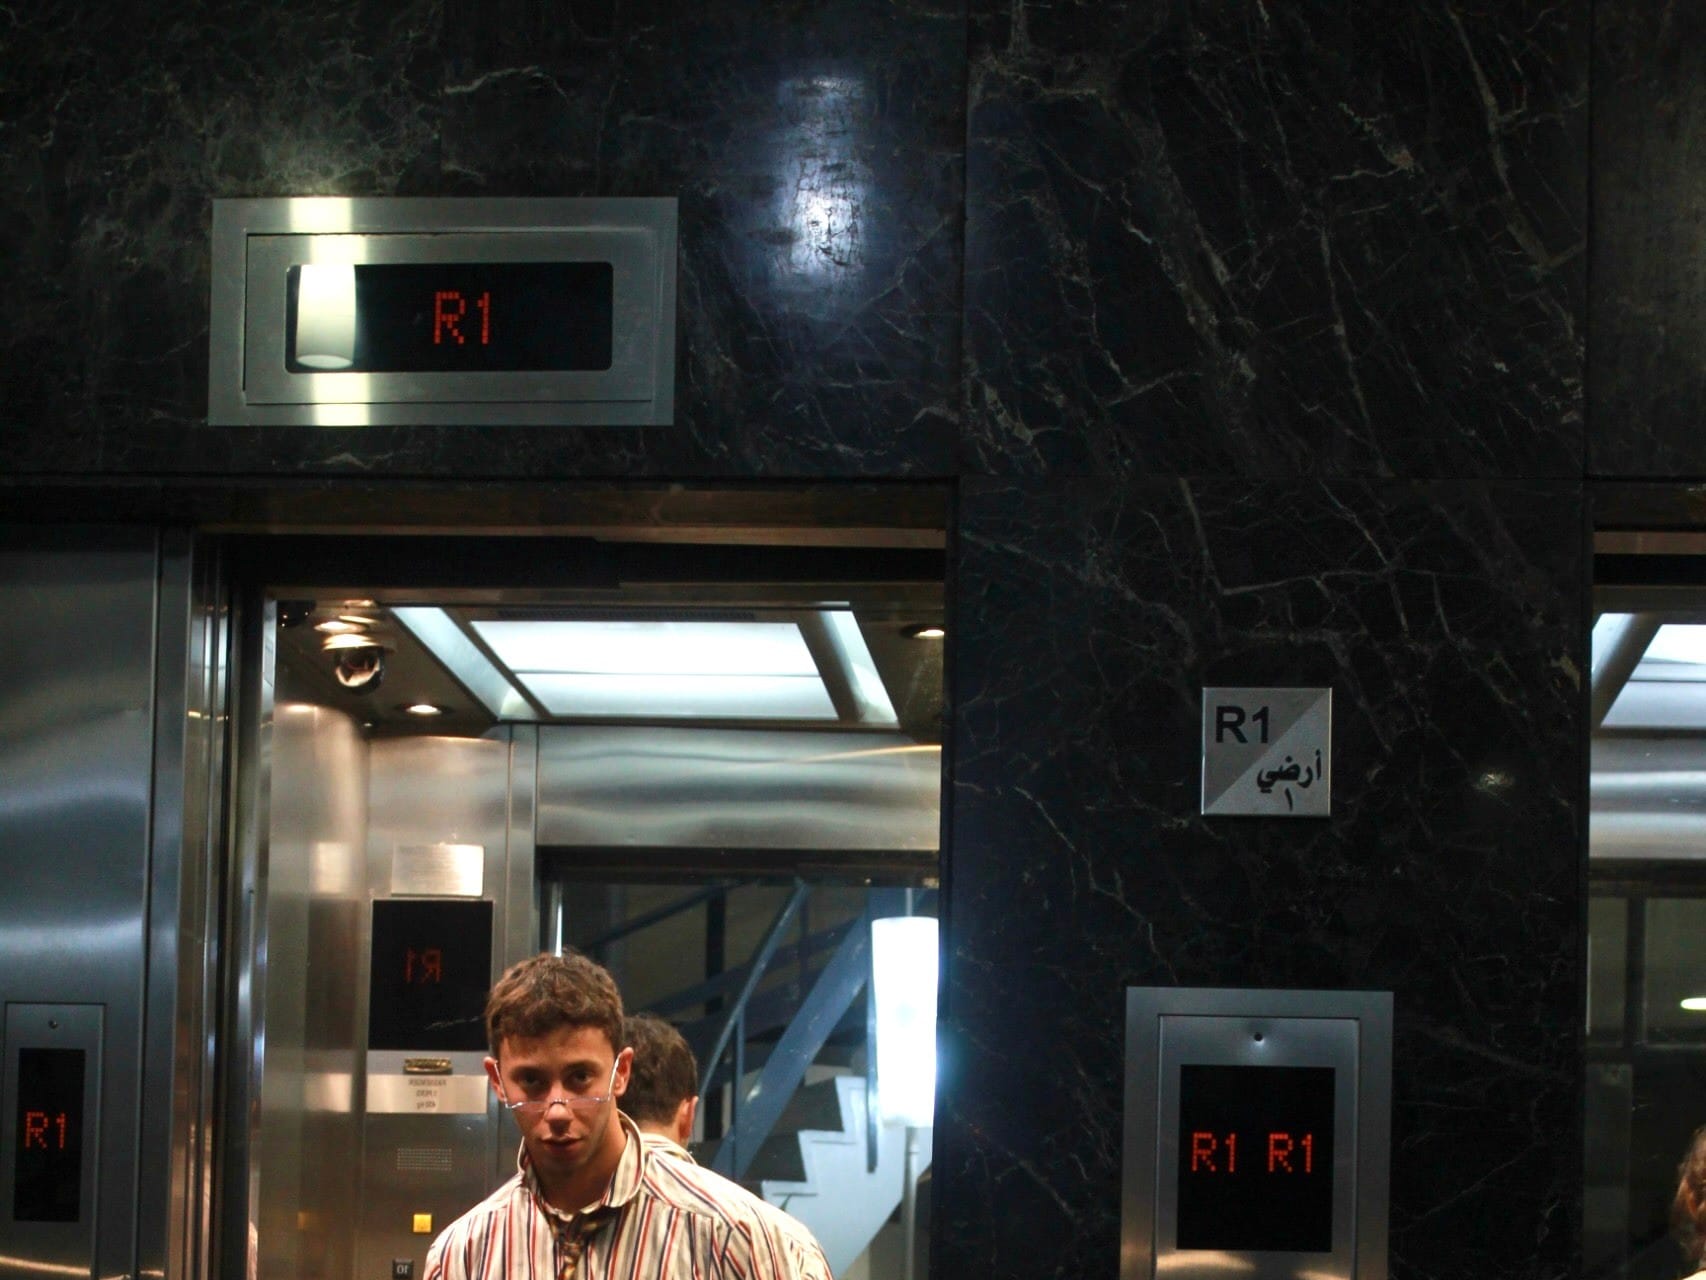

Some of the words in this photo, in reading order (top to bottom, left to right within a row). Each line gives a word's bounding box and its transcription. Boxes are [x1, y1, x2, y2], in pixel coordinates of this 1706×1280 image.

[433, 291, 491, 346] R1
[1216, 706, 1269, 743] R1
[1257, 749, 1322, 794] أرضي
[24, 1110, 70, 1150] R1
[1190, 1130, 1239, 1176] R1
[1266, 1130, 1315, 1176] R1
